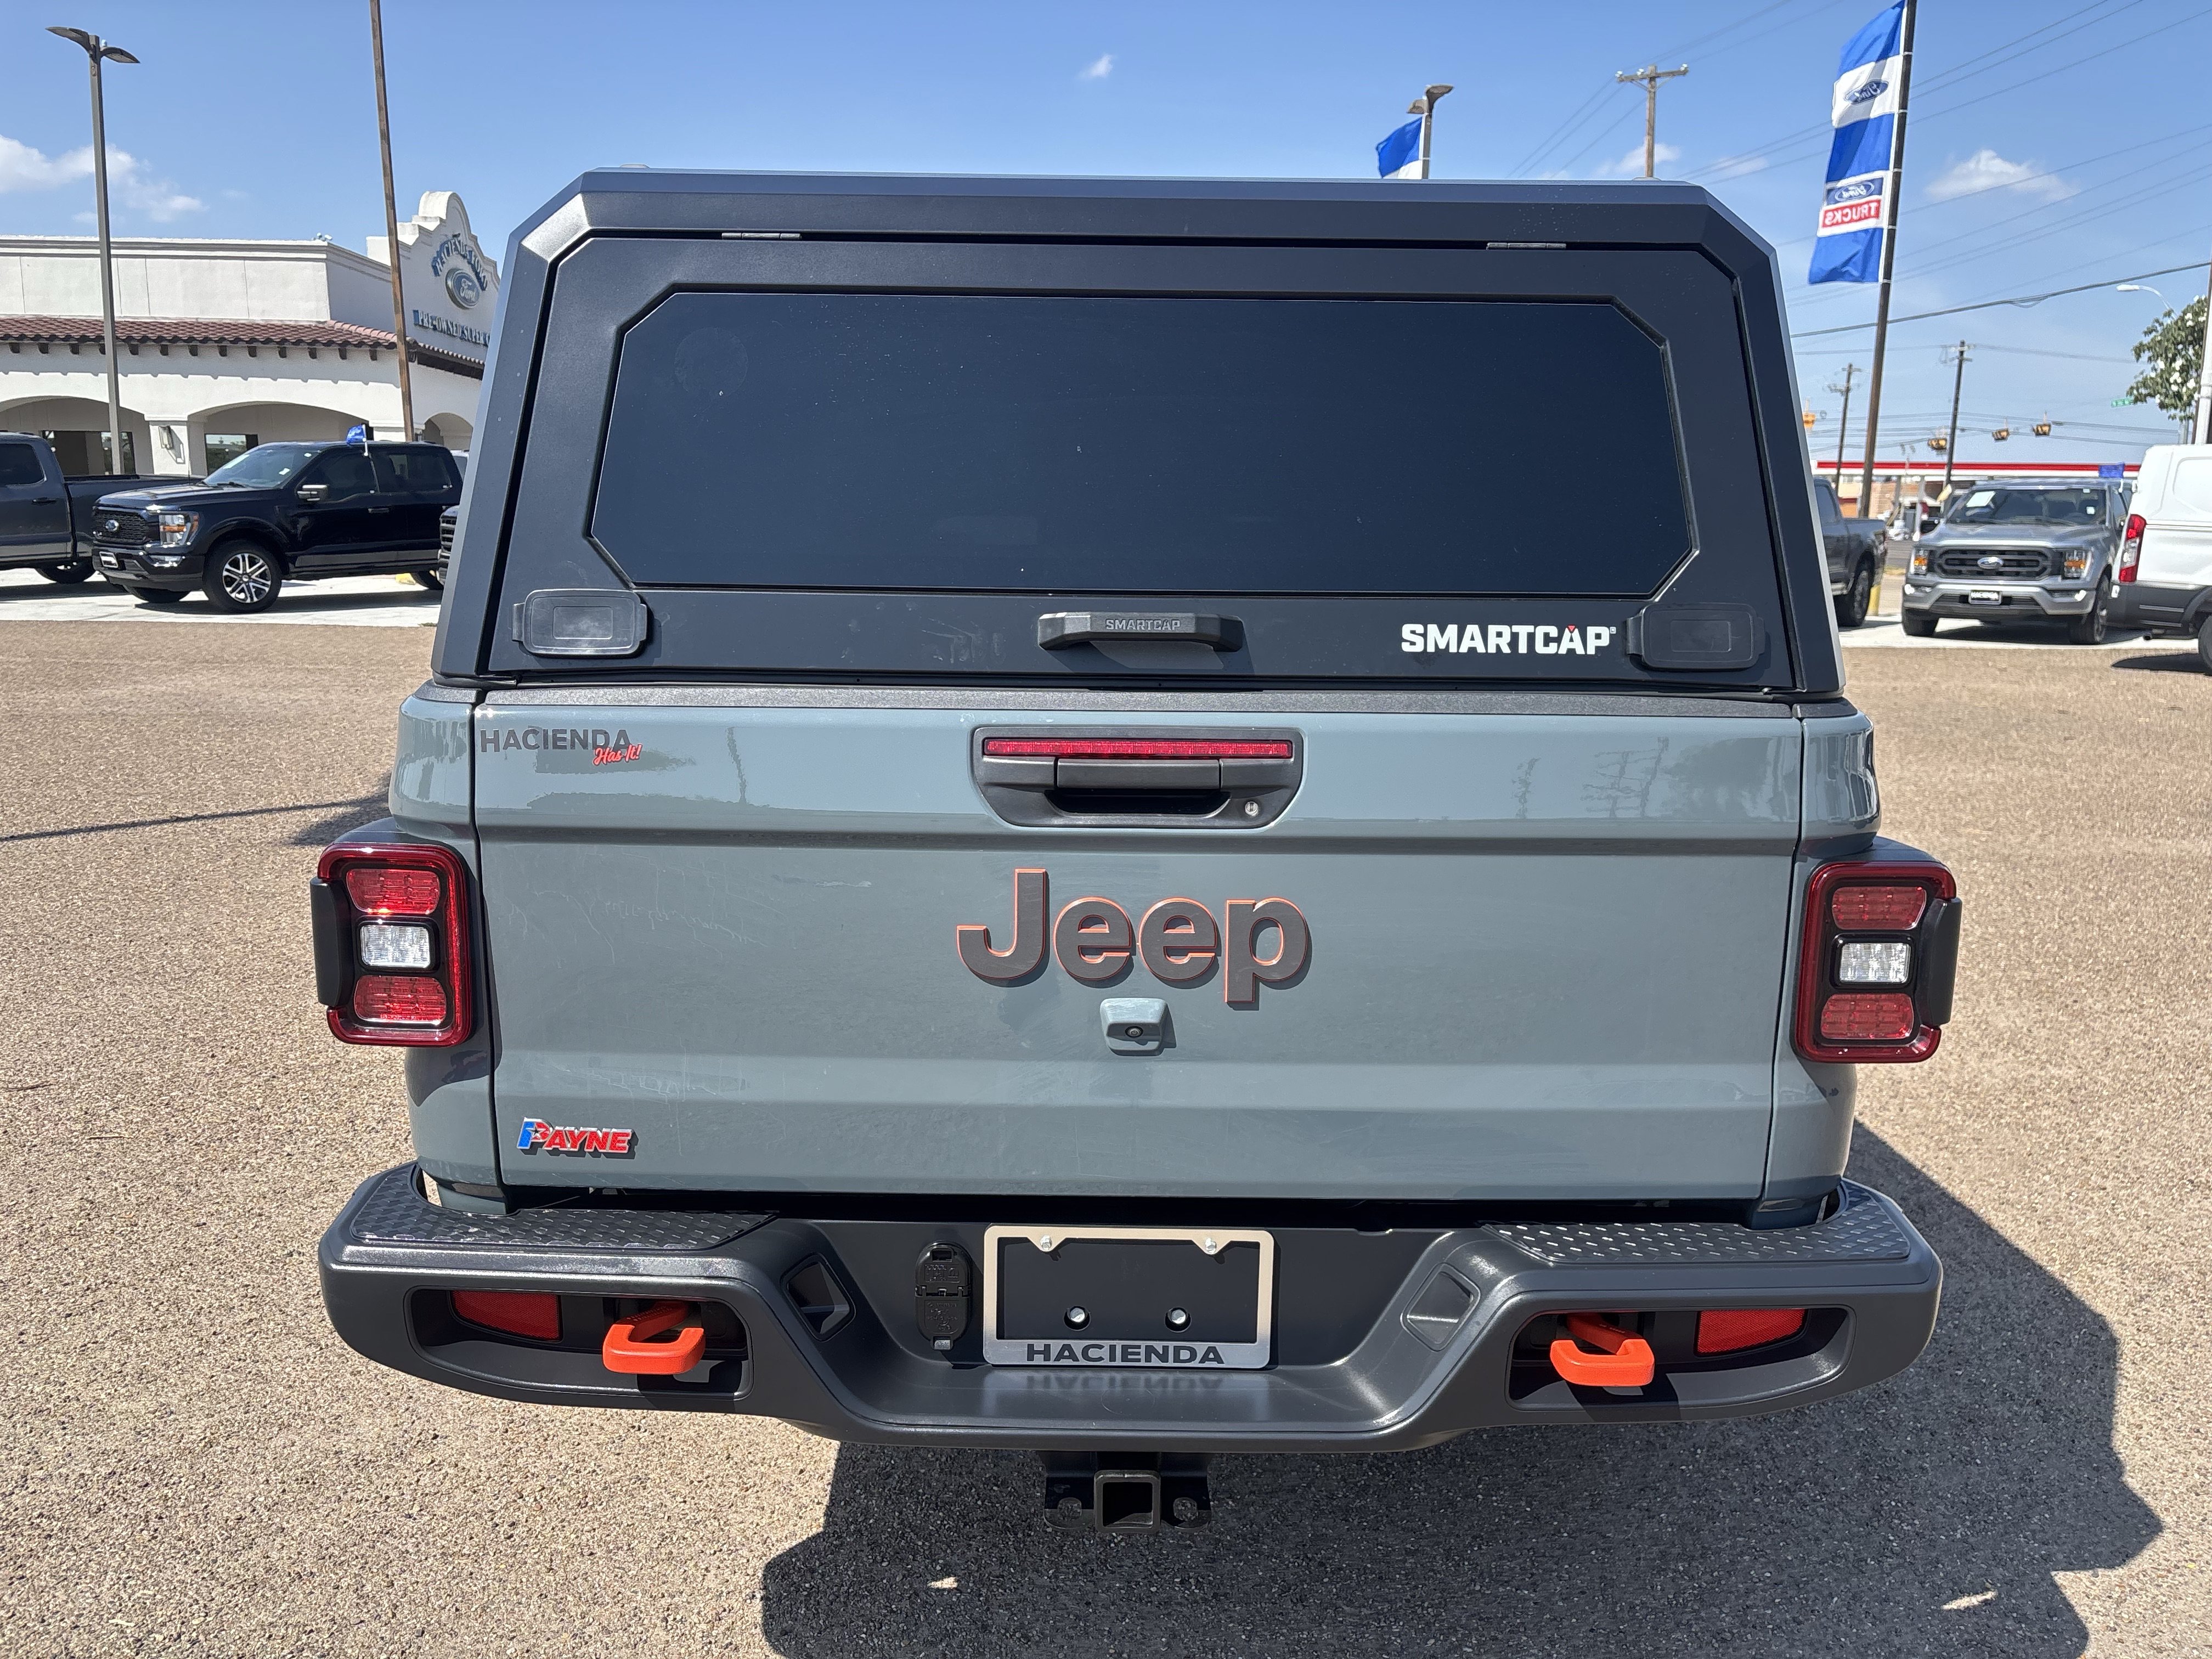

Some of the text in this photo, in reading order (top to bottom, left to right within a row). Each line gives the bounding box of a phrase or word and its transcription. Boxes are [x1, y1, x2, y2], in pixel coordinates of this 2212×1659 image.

[1105, 619, 1180, 630] SMARTCAP
[481, 729, 631, 752] HACIENDA
[593, 743, 643, 766] Has It!
[957, 868, 1309, 1003] Jeep
[517, 1117, 633, 1153] PAYNE
[1026, 1344, 1224, 1364] HACIENDA
